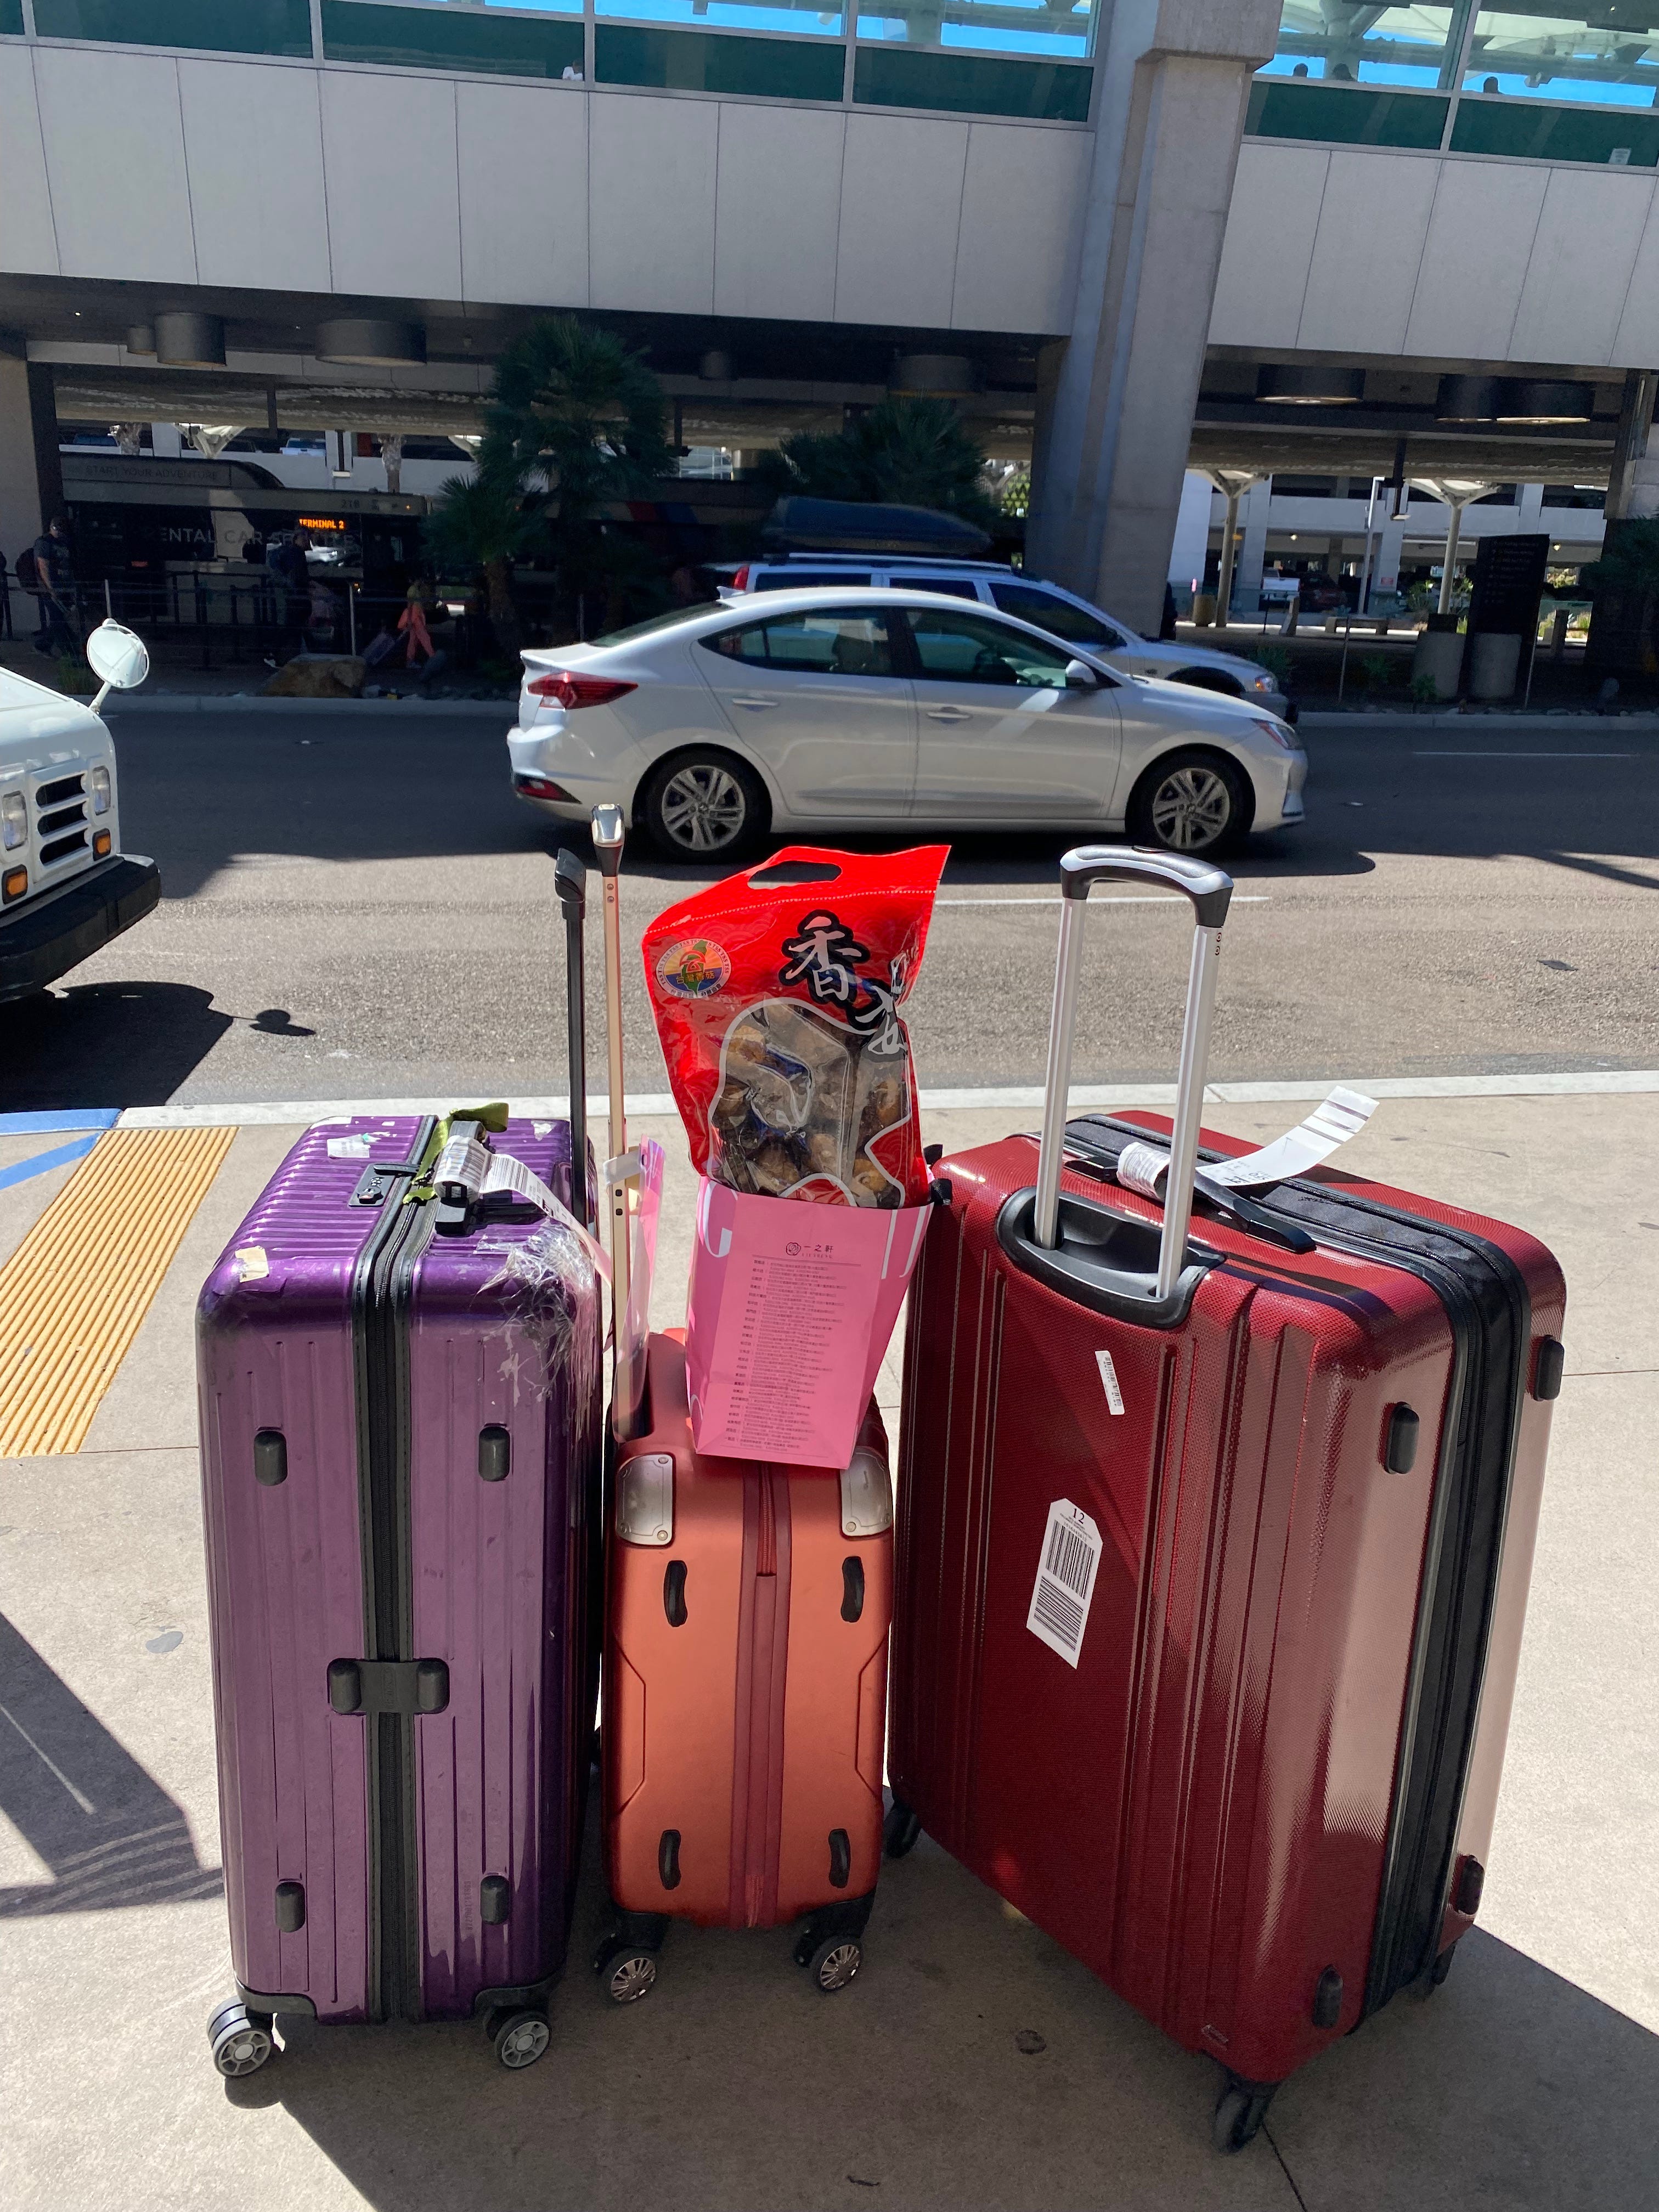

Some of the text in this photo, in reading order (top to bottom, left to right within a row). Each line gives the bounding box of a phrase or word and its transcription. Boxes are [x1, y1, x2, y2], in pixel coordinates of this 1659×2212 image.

[299, 518, 345, 531] TERMINAL 2
[224, 529, 263, 545] CAR
[804, 1244, 834, 1252] 一之軒
[1073, 1508, 1085, 1525] 12
